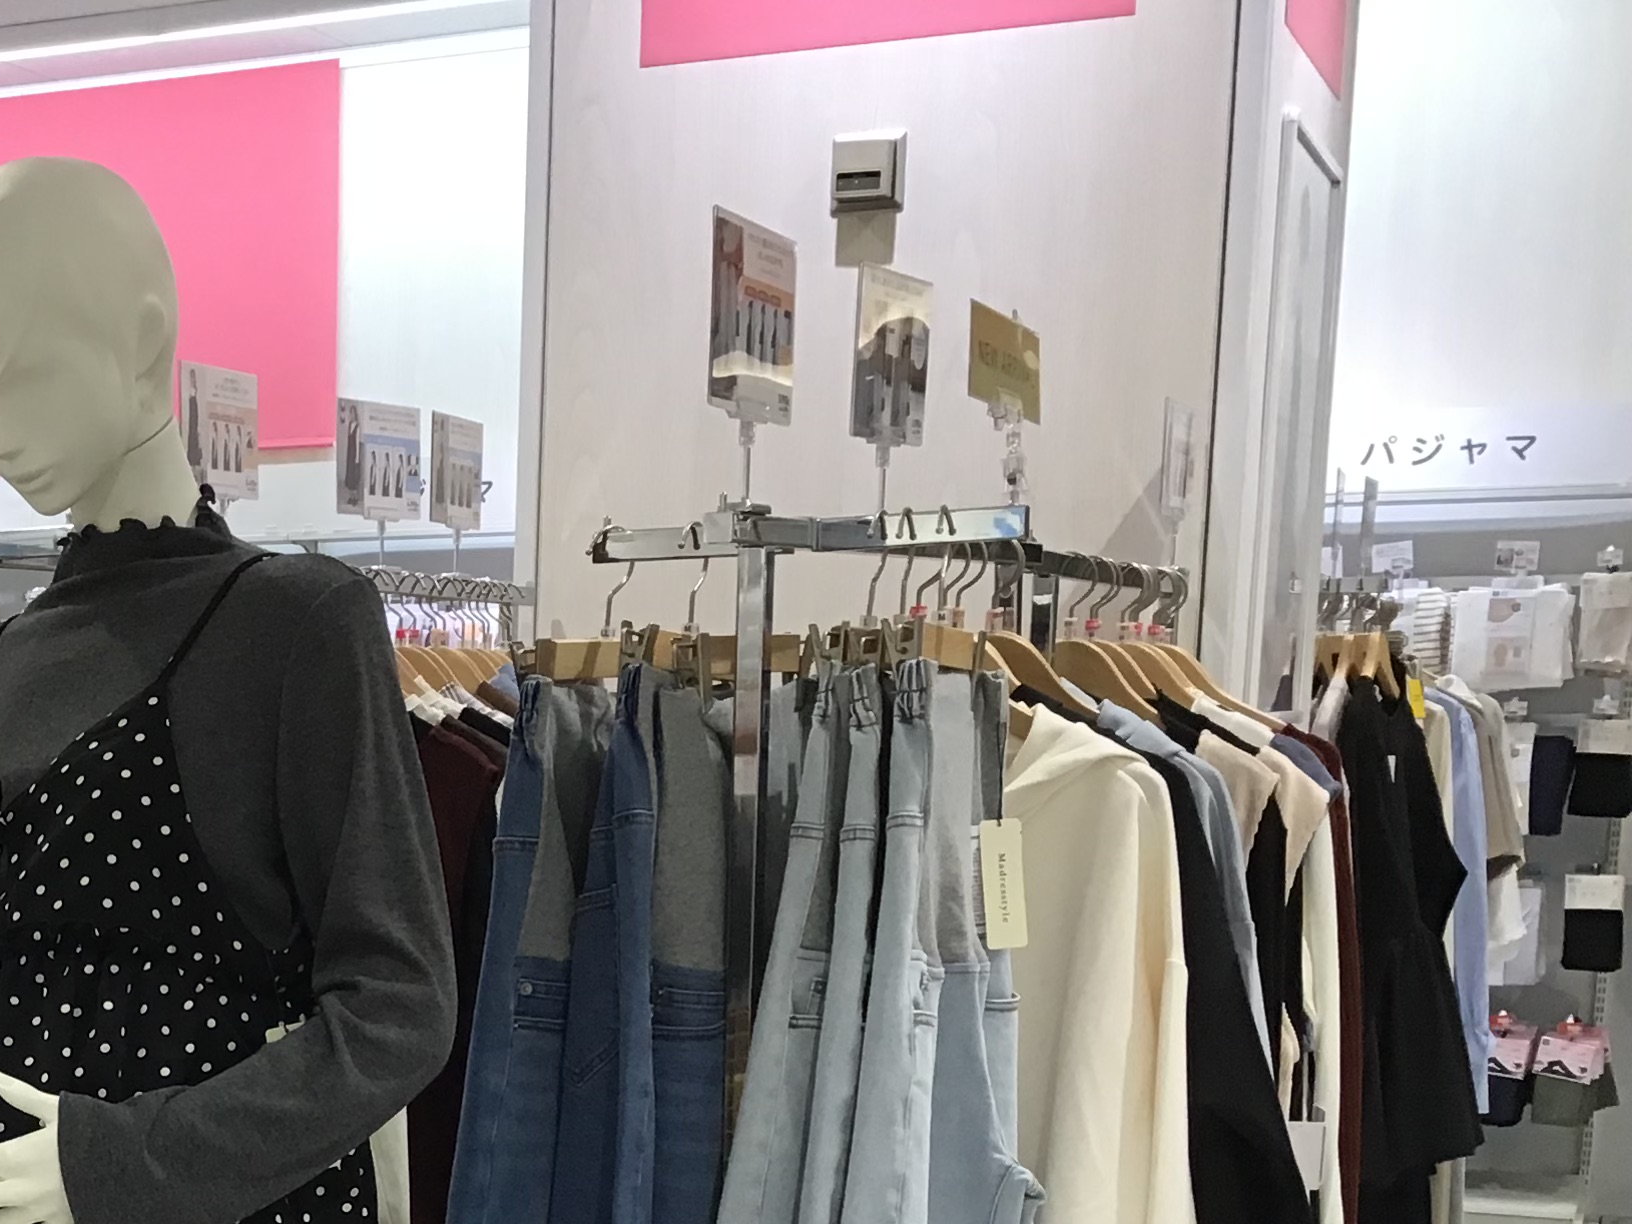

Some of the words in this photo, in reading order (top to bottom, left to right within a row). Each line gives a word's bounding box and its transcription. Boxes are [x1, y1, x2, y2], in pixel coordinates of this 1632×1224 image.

[1360, 432, 1538, 468] パジャマ
[997, 852, 1011, 924] Madresstyle
